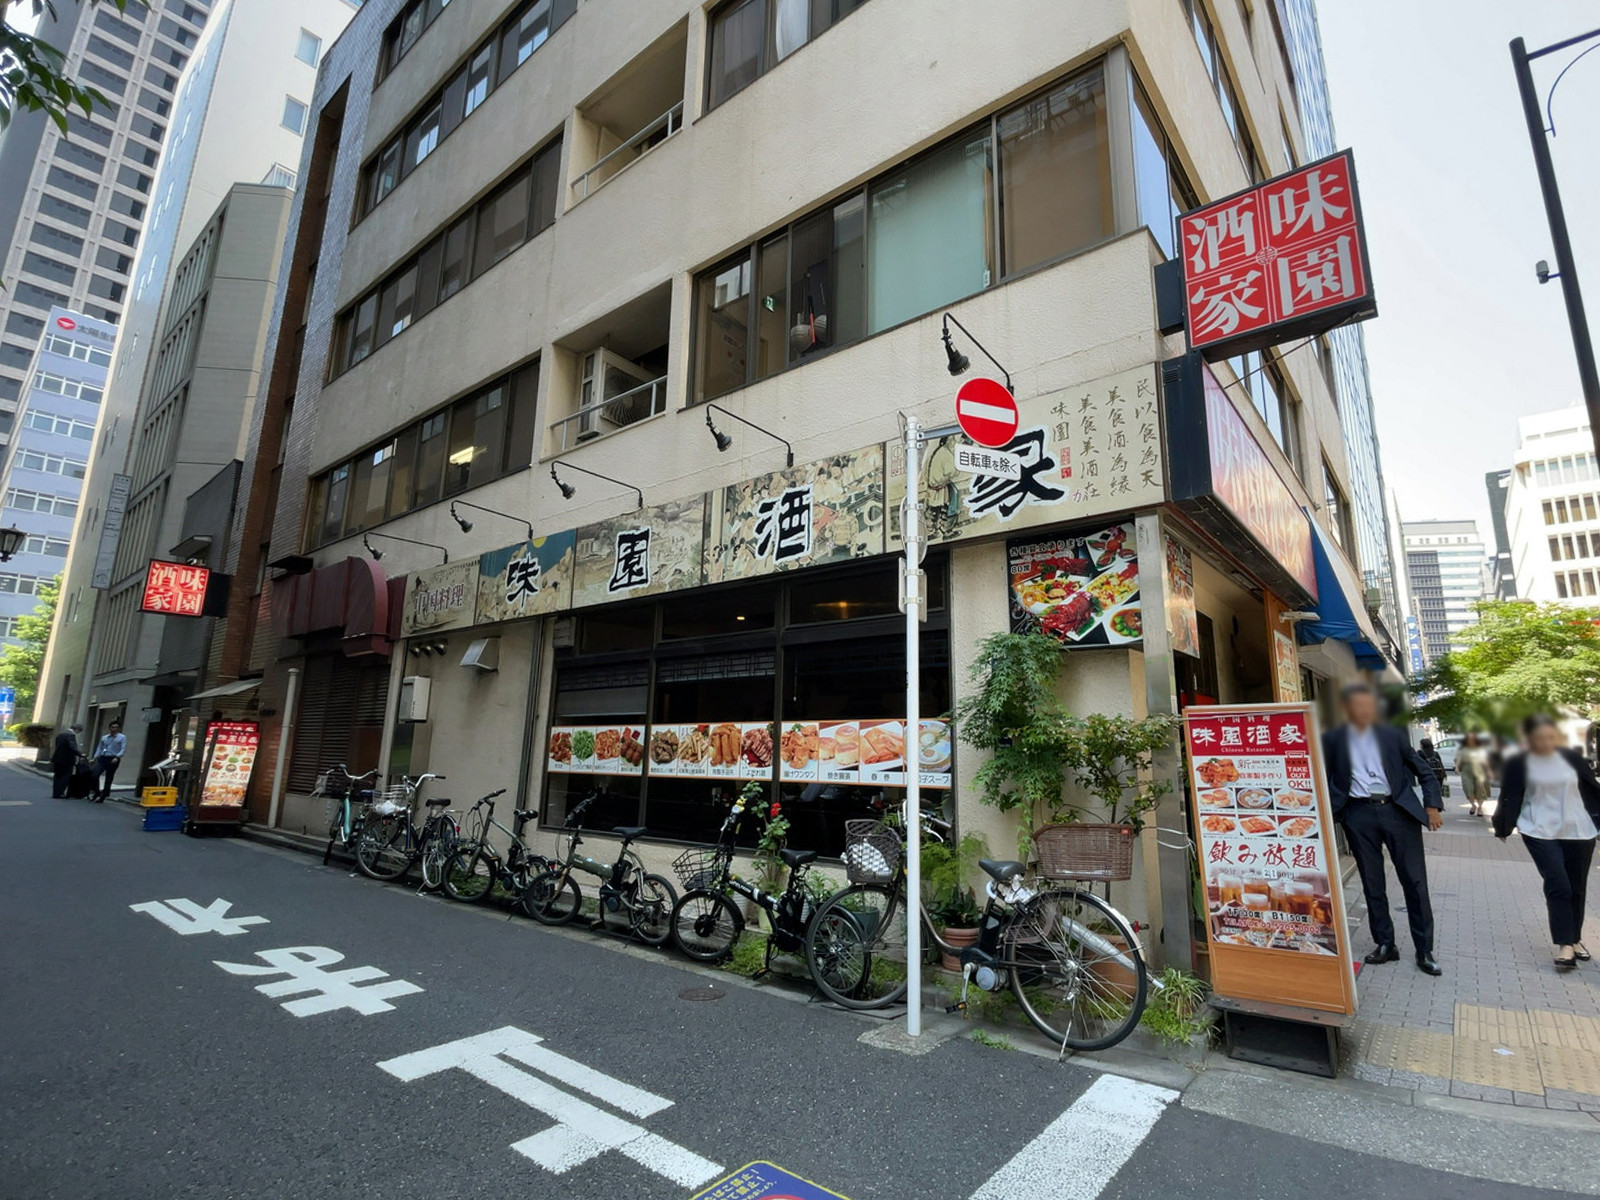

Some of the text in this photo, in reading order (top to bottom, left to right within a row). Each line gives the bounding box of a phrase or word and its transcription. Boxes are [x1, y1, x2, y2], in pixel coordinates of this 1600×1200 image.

[1267, 169, 1356, 317] 味園
[1187, 197, 1265, 338] 酒家
[959, 451, 1018, 475] 自転車を除く
[145, 562, 179, 610] 酒家
[1191, 723, 1304, 747] 味園酒家
[1287, 780, 1312, 789] OK!!
[1208, 840, 1320, 871] 飲み放題
[130, 896, 726, 1189] 止まれ
